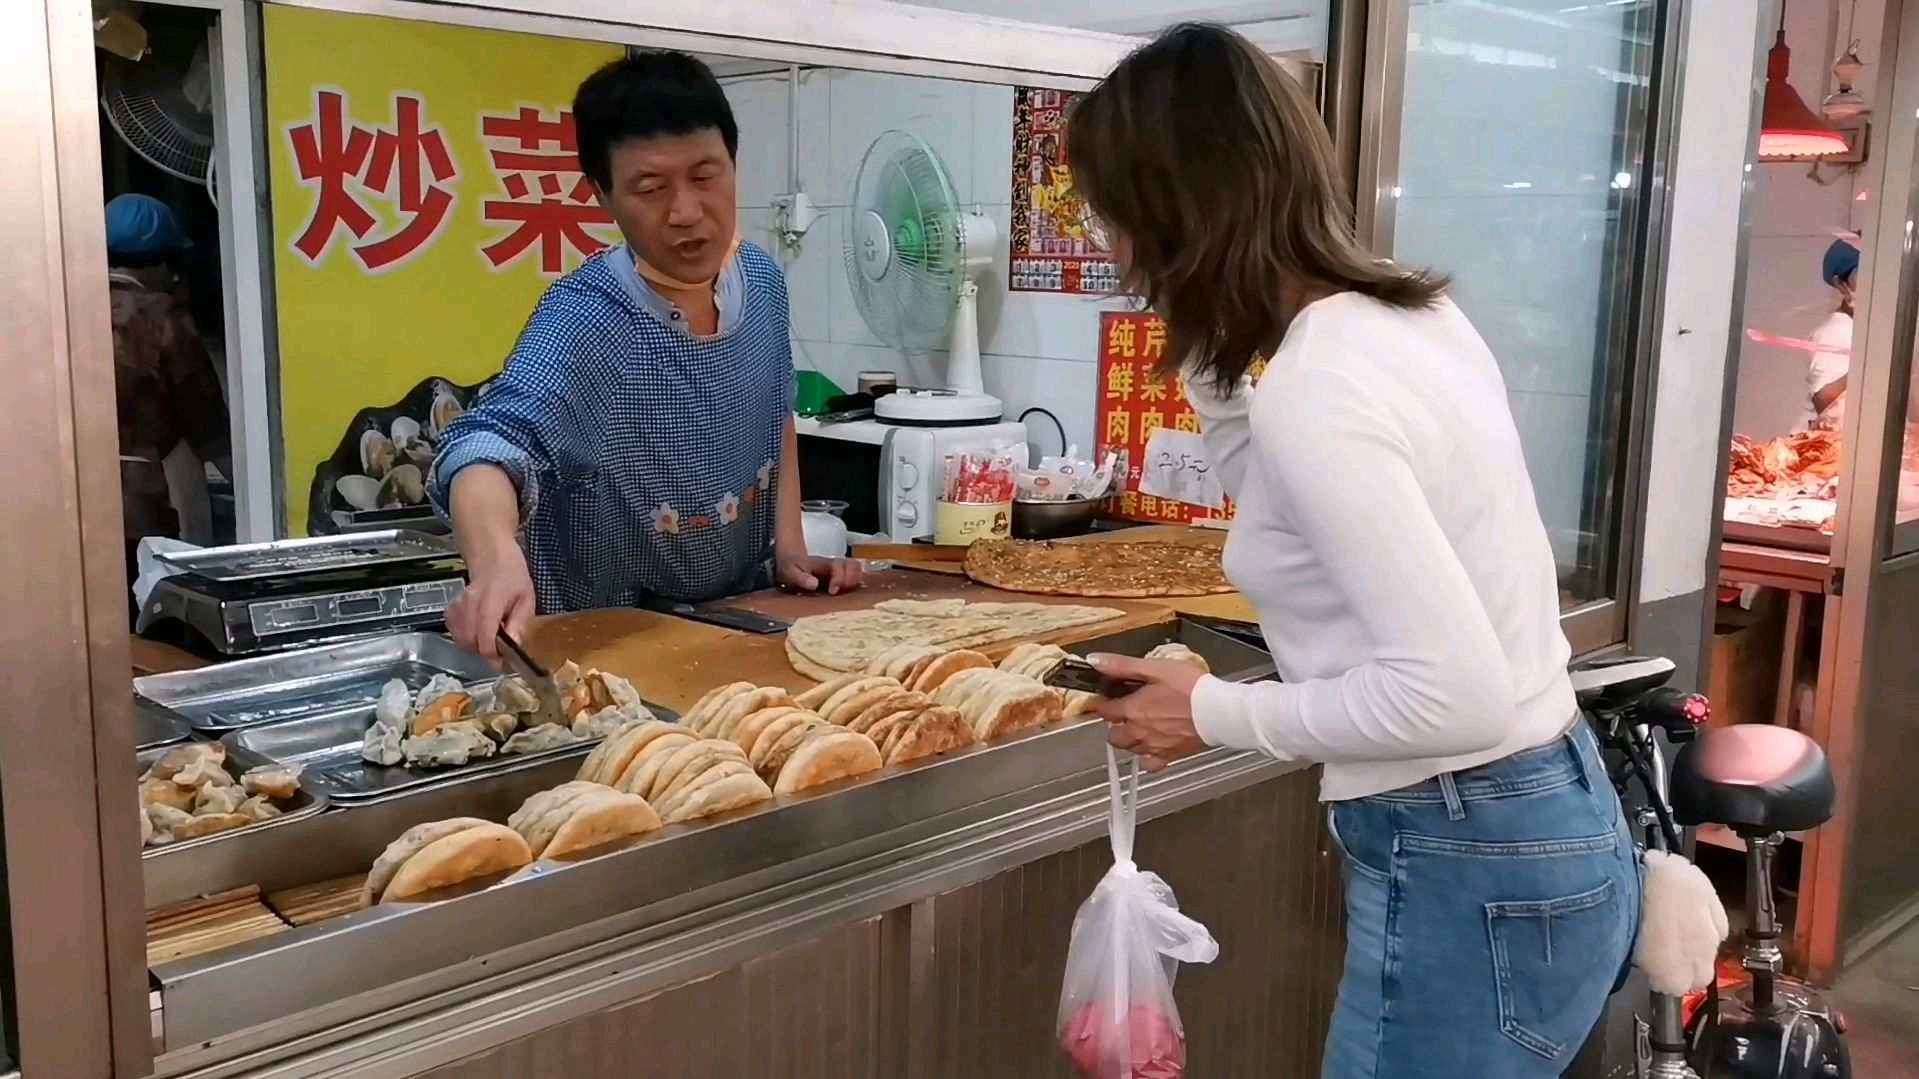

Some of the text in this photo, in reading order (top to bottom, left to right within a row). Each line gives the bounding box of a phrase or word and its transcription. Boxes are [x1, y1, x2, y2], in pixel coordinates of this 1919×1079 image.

[288, 90, 617, 273] 炒菜
[1106, 318, 1136, 444] 纯鲜肉
